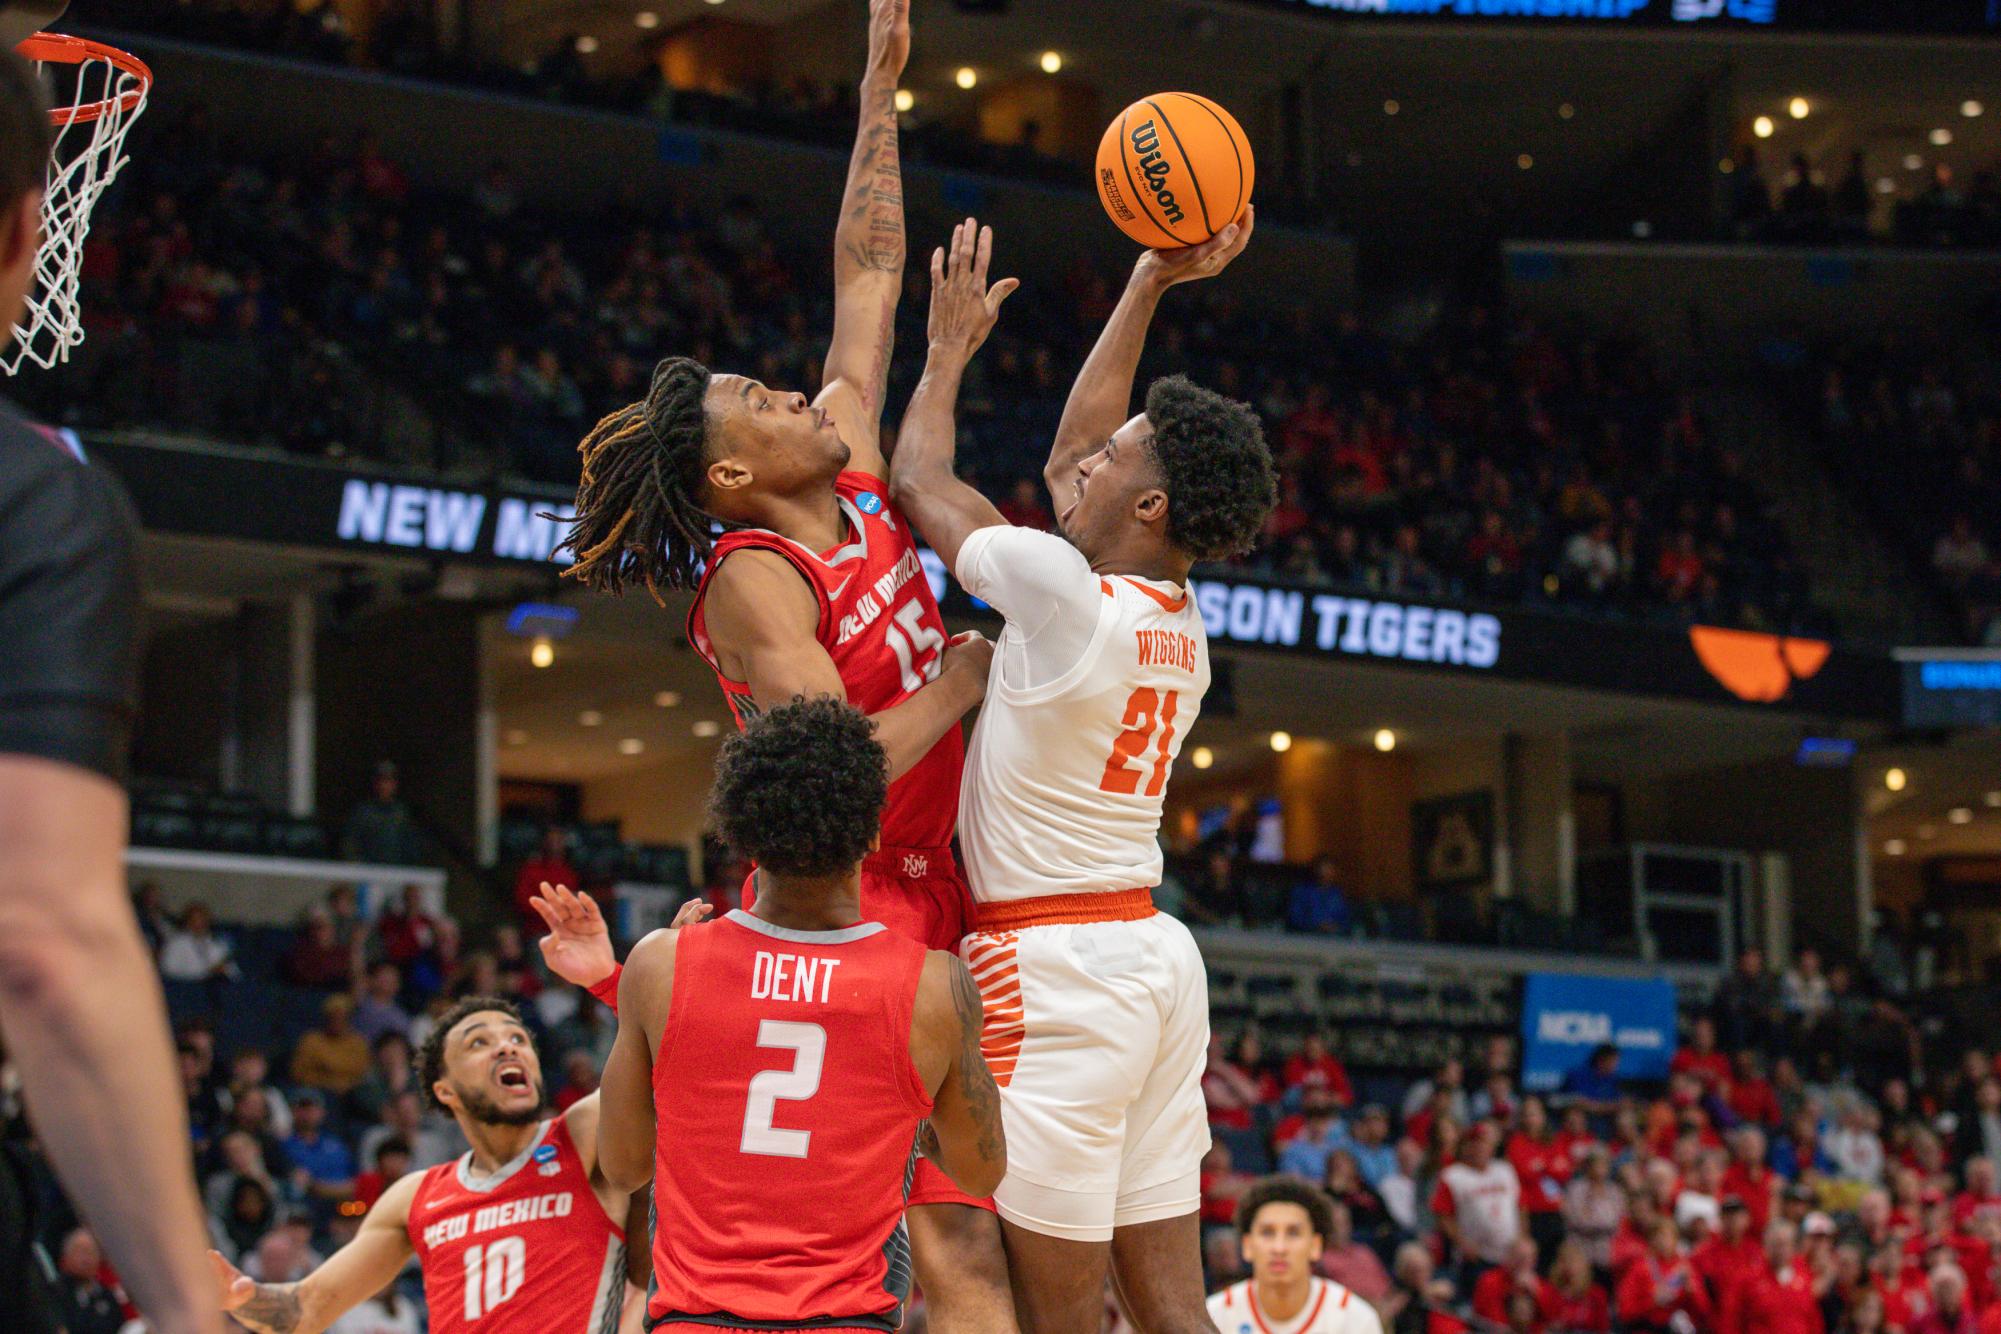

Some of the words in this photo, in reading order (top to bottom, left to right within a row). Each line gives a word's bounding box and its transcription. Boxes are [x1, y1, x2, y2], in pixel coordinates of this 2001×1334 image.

[1131, 119, 1185, 225] Wilson
[337, 479, 487, 554] NEW
[837, 592, 882, 645] NEW
[885, 597, 945, 693] 15
[1136, 629, 1197, 674] WIGGINS
[1197, 580, 1304, 646] SON
[1312, 594, 1502, 669] TIGERS
[1099, 686, 1179, 797] 21
[751, 951, 841, 1003] DENT
[740, 1019, 827, 1158] 2
[423, 1213, 470, 1250] NEW
[473, 1192, 573, 1233] MEXICO
[463, 1235, 525, 1322] 10
